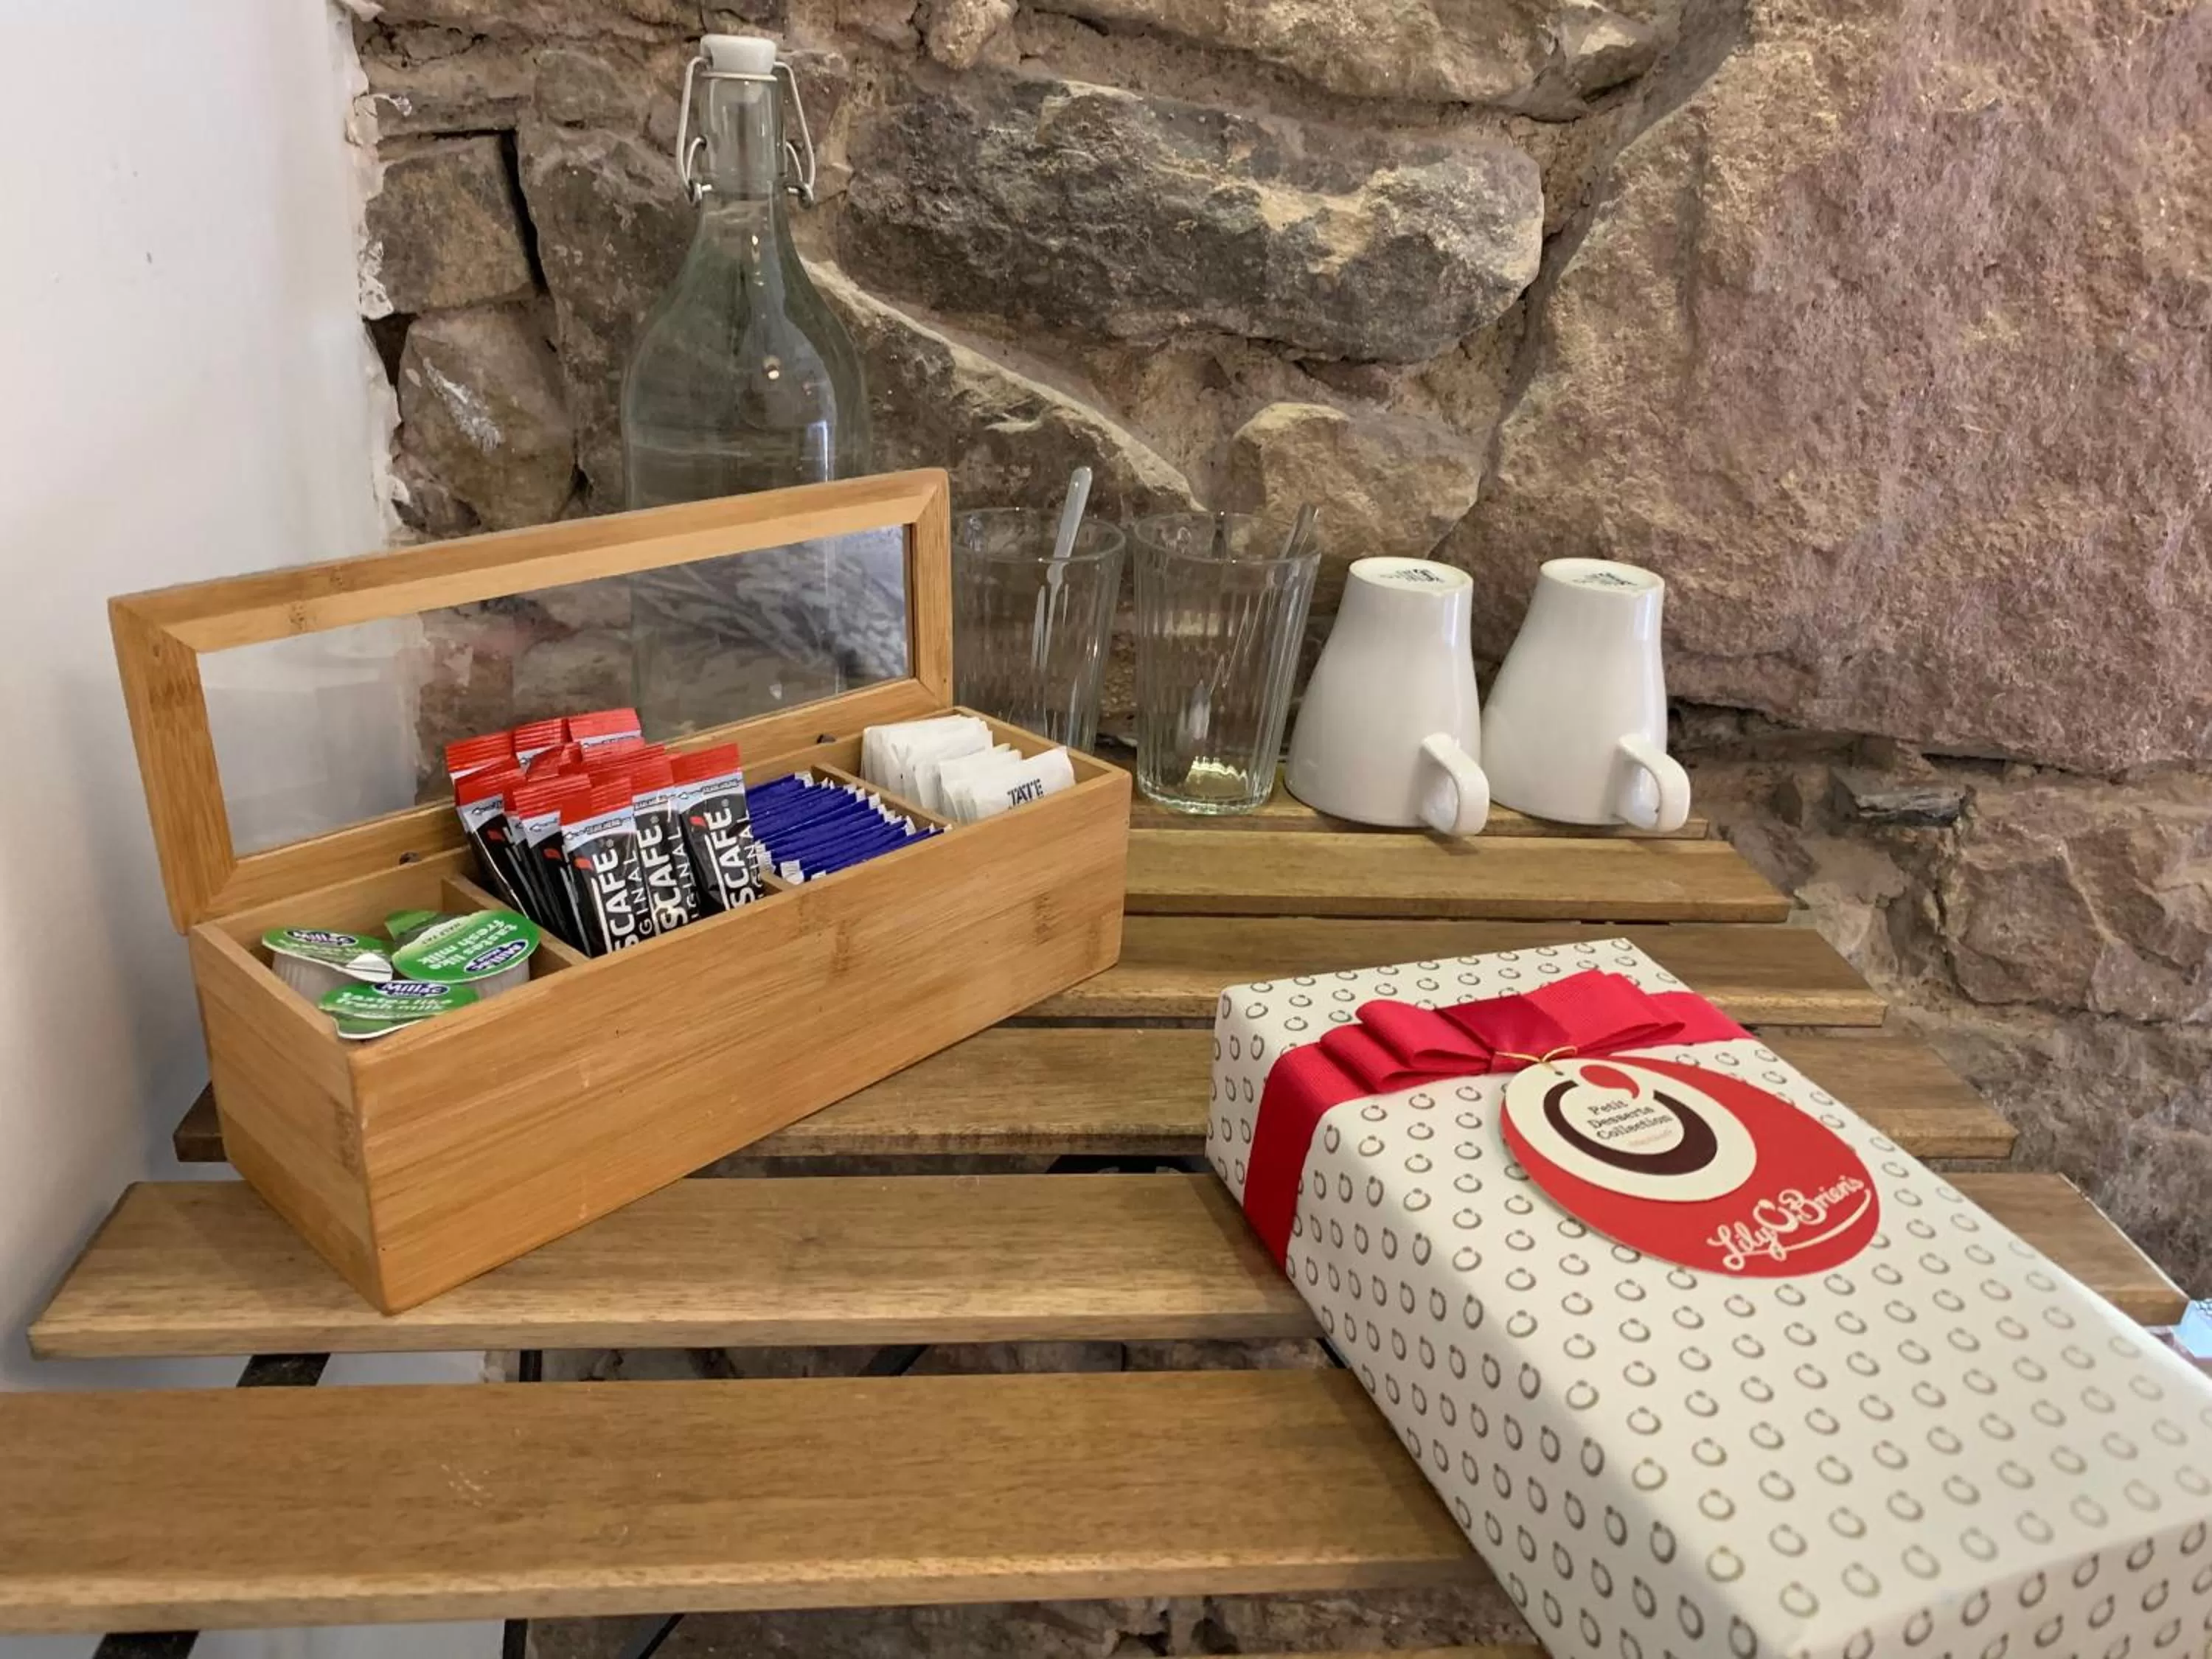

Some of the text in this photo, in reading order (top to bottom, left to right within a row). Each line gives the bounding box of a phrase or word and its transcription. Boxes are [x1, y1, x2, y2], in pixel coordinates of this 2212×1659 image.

[1007, 779, 1043, 806] TATE
[624, 849, 653, 935] GINAL
[380, 981, 442, 994] Millac
[1586, 1106, 1655, 1129] Desserts
[1587, 1099, 1629, 1115] Petit
[1596, 1115, 1674, 1140] Collection
[1706, 1220, 1787, 1271] Lily
